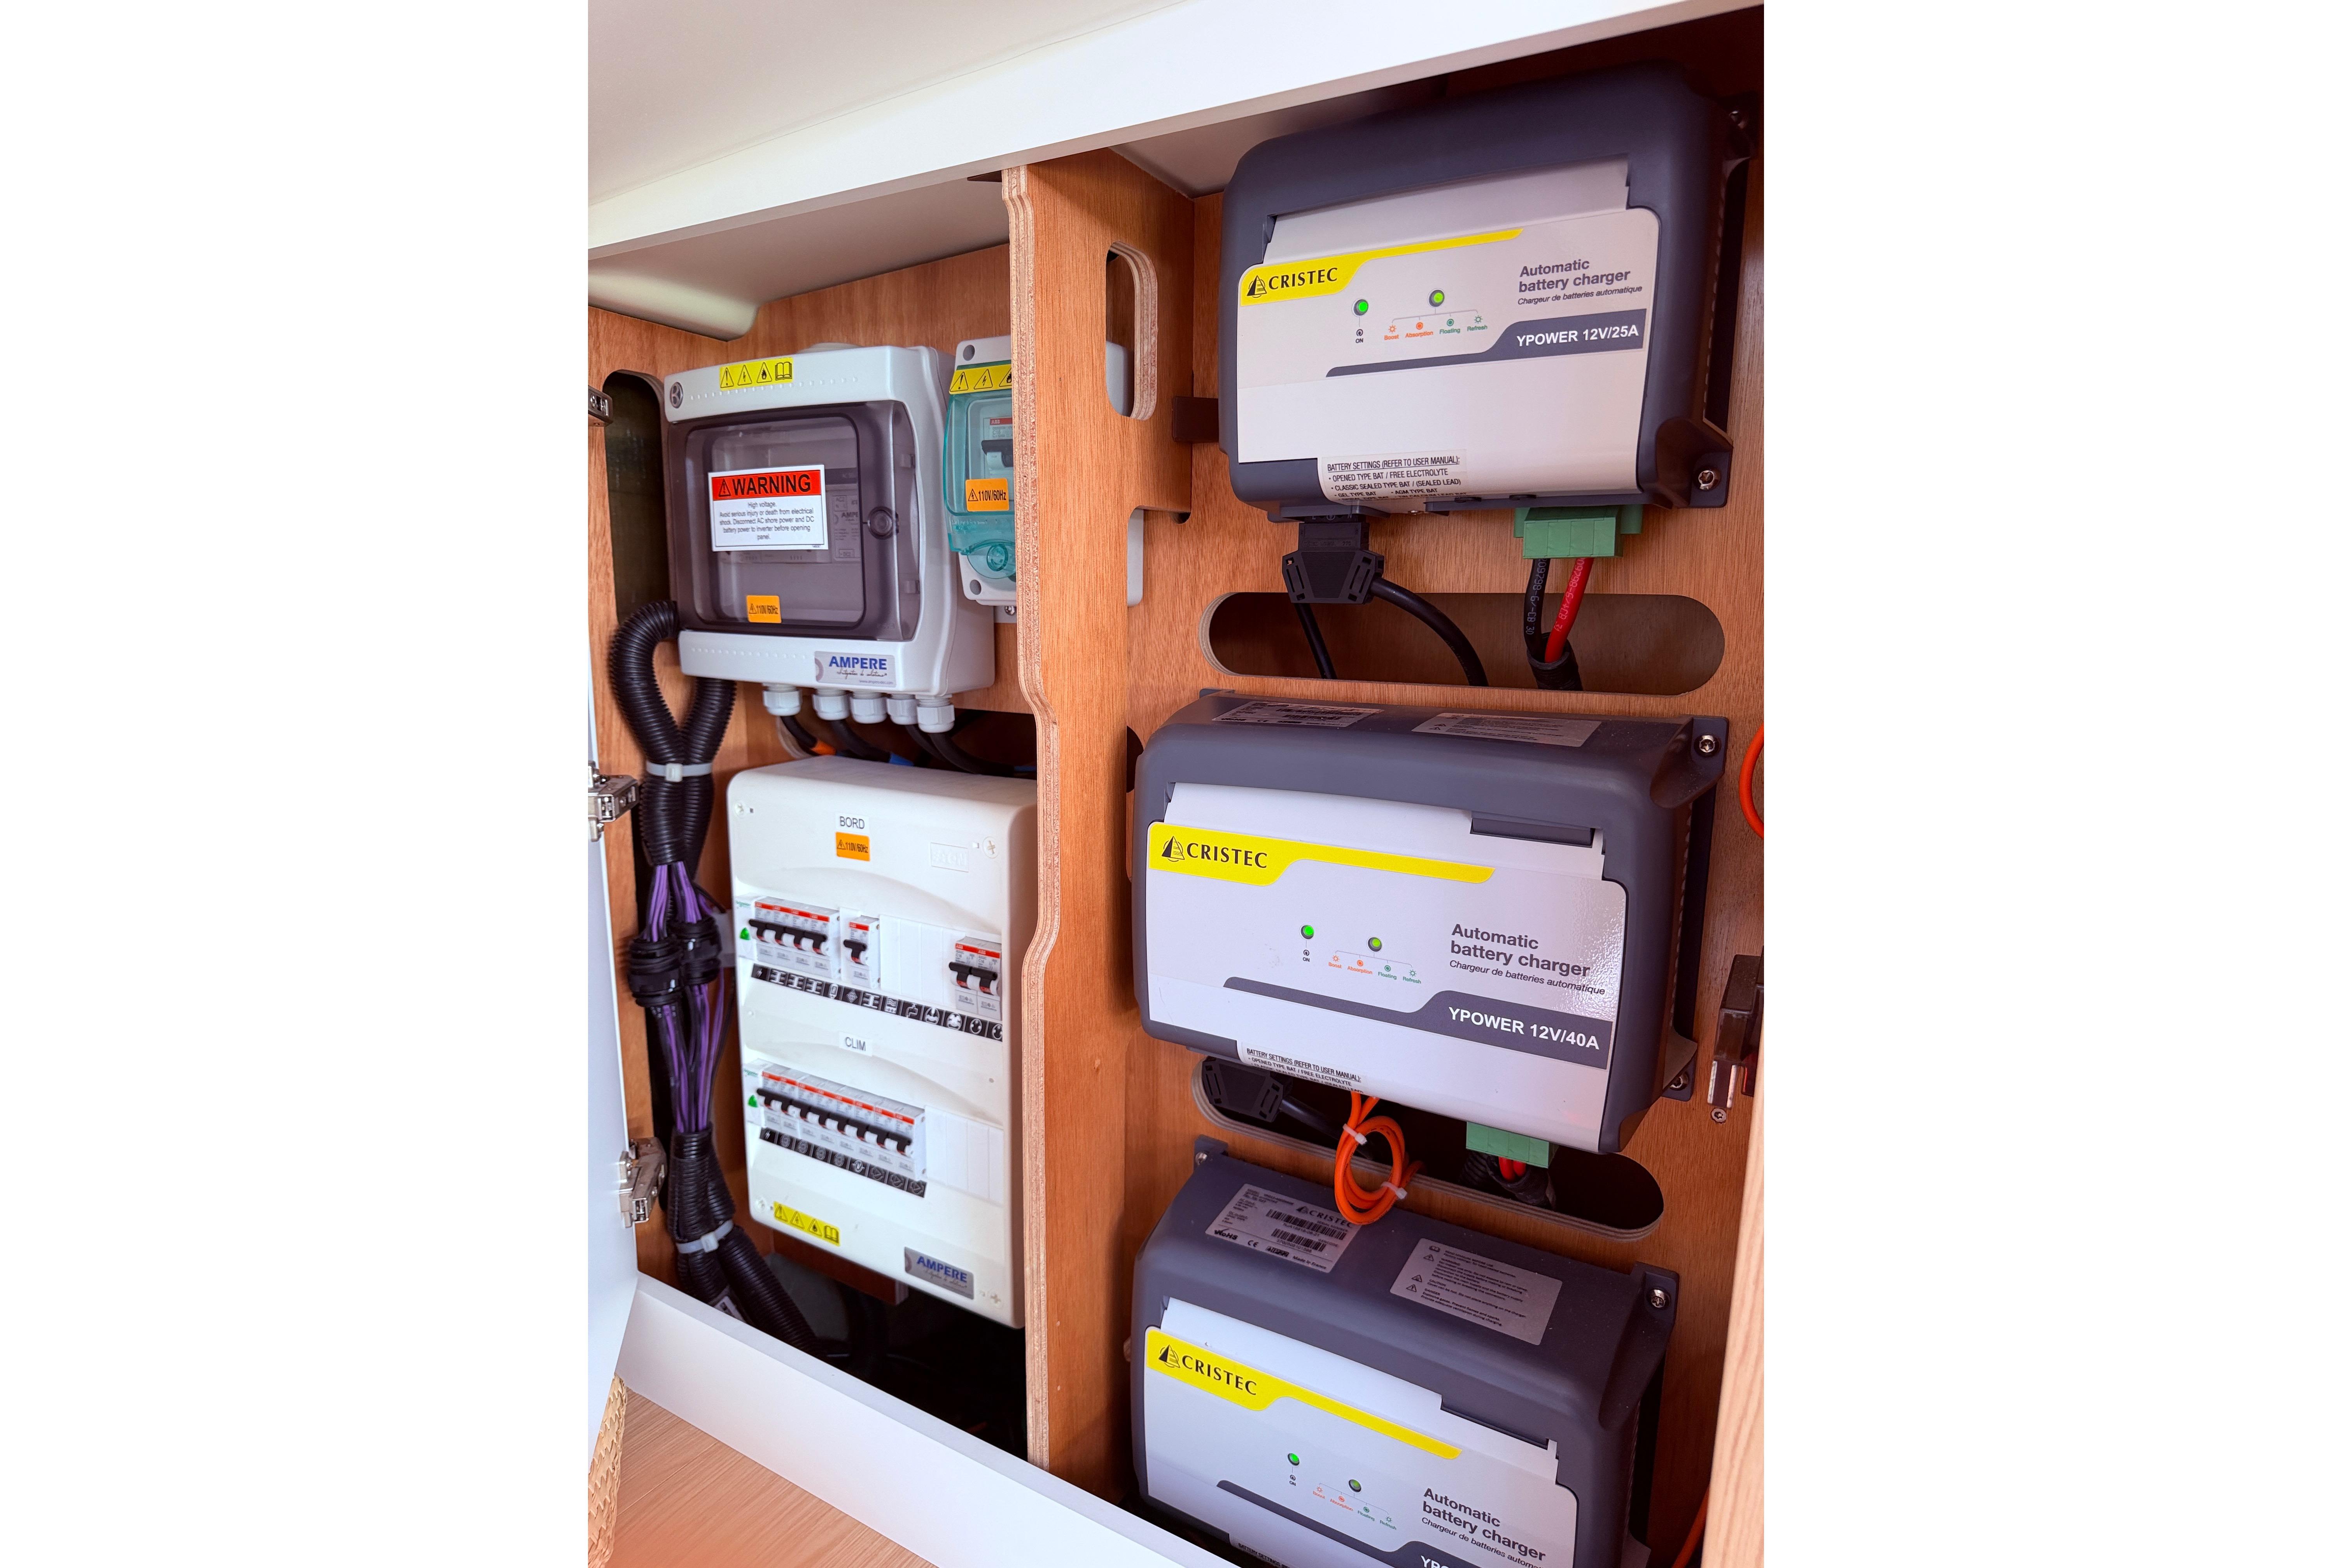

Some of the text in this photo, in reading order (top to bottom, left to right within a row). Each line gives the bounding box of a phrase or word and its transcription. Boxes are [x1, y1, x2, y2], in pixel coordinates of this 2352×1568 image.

[1520, 259, 1589, 277] Automatic
[1269, 268, 1337, 290] CRISTEC
[1519, 271, 1630, 292] battery charger
[1518, 296, 1550, 305] Chargeur
[1563, 291, 1594, 300] batteries
[1596, 286, 1642, 296] automatique
[1517, 325, 1639, 346] YPOWER 12V/25A
[1327, 463, 1351, 471] BATTERY
[1353, 461, 1380, 469] SETTINGS
[1382, 459, 1402, 469] (REFER
[1413, 457, 1428, 466] USER
[1431, 456, 1460, 464] MANUAL):
[1407, 469, 1448, 478] ELECTROLYTE
[732, 474, 810, 495] WARNING
[978, 490, 1006, 501] 110V/60Hz
[756, 605, 778, 614] 110V/60Hz
[829, 656, 887, 670] AMPERE
[840, 816, 865, 829] BORD
[845, 842, 868, 853] 110V/60Hz
[1187, 843, 1267, 868] CRISTEC
[1452, 924, 1538, 949] Automatic
[1451, 940, 1591, 976] battery charger
[1348, 966, 1372, 975] Absorption
[1378, 972, 1397, 980] Floating
[1449, 960, 1605, 995] Chargeur de batteries automatique
[1449, 1007, 1599, 1050] YPOWER 12V/40A
[845, 1037, 866, 1051] CLIM
[1247, 1048, 1267, 1058] BATTERY
[1269, 1054, 1292, 1064] SETTINGS
[1294, 1060, 1311, 1069] (REFER
[1321, 1066, 1334, 1074] USER
[1336, 1070, 1361, 1082] MANUAL):
[1251, 1057, 1272, 1066] OPENED
[1315, 1073, 1352, 1086] ELECTROLYTE
[1310, 1210, 1353, 1228] CRISTEC
[916, 1256, 967, 1283] AMPERE
[1182, 1355, 1256, 1395] CRISTEC
[1358, 1510, 1375, 1521] Floating
[1423, 1488, 1500, 1527] Automatic
[1422, 1517, 1458, 1536] Chargeur
[1471, 1538, 1505, 1557] batteries
[1423, 1500, 1546, 1561] battery charger
